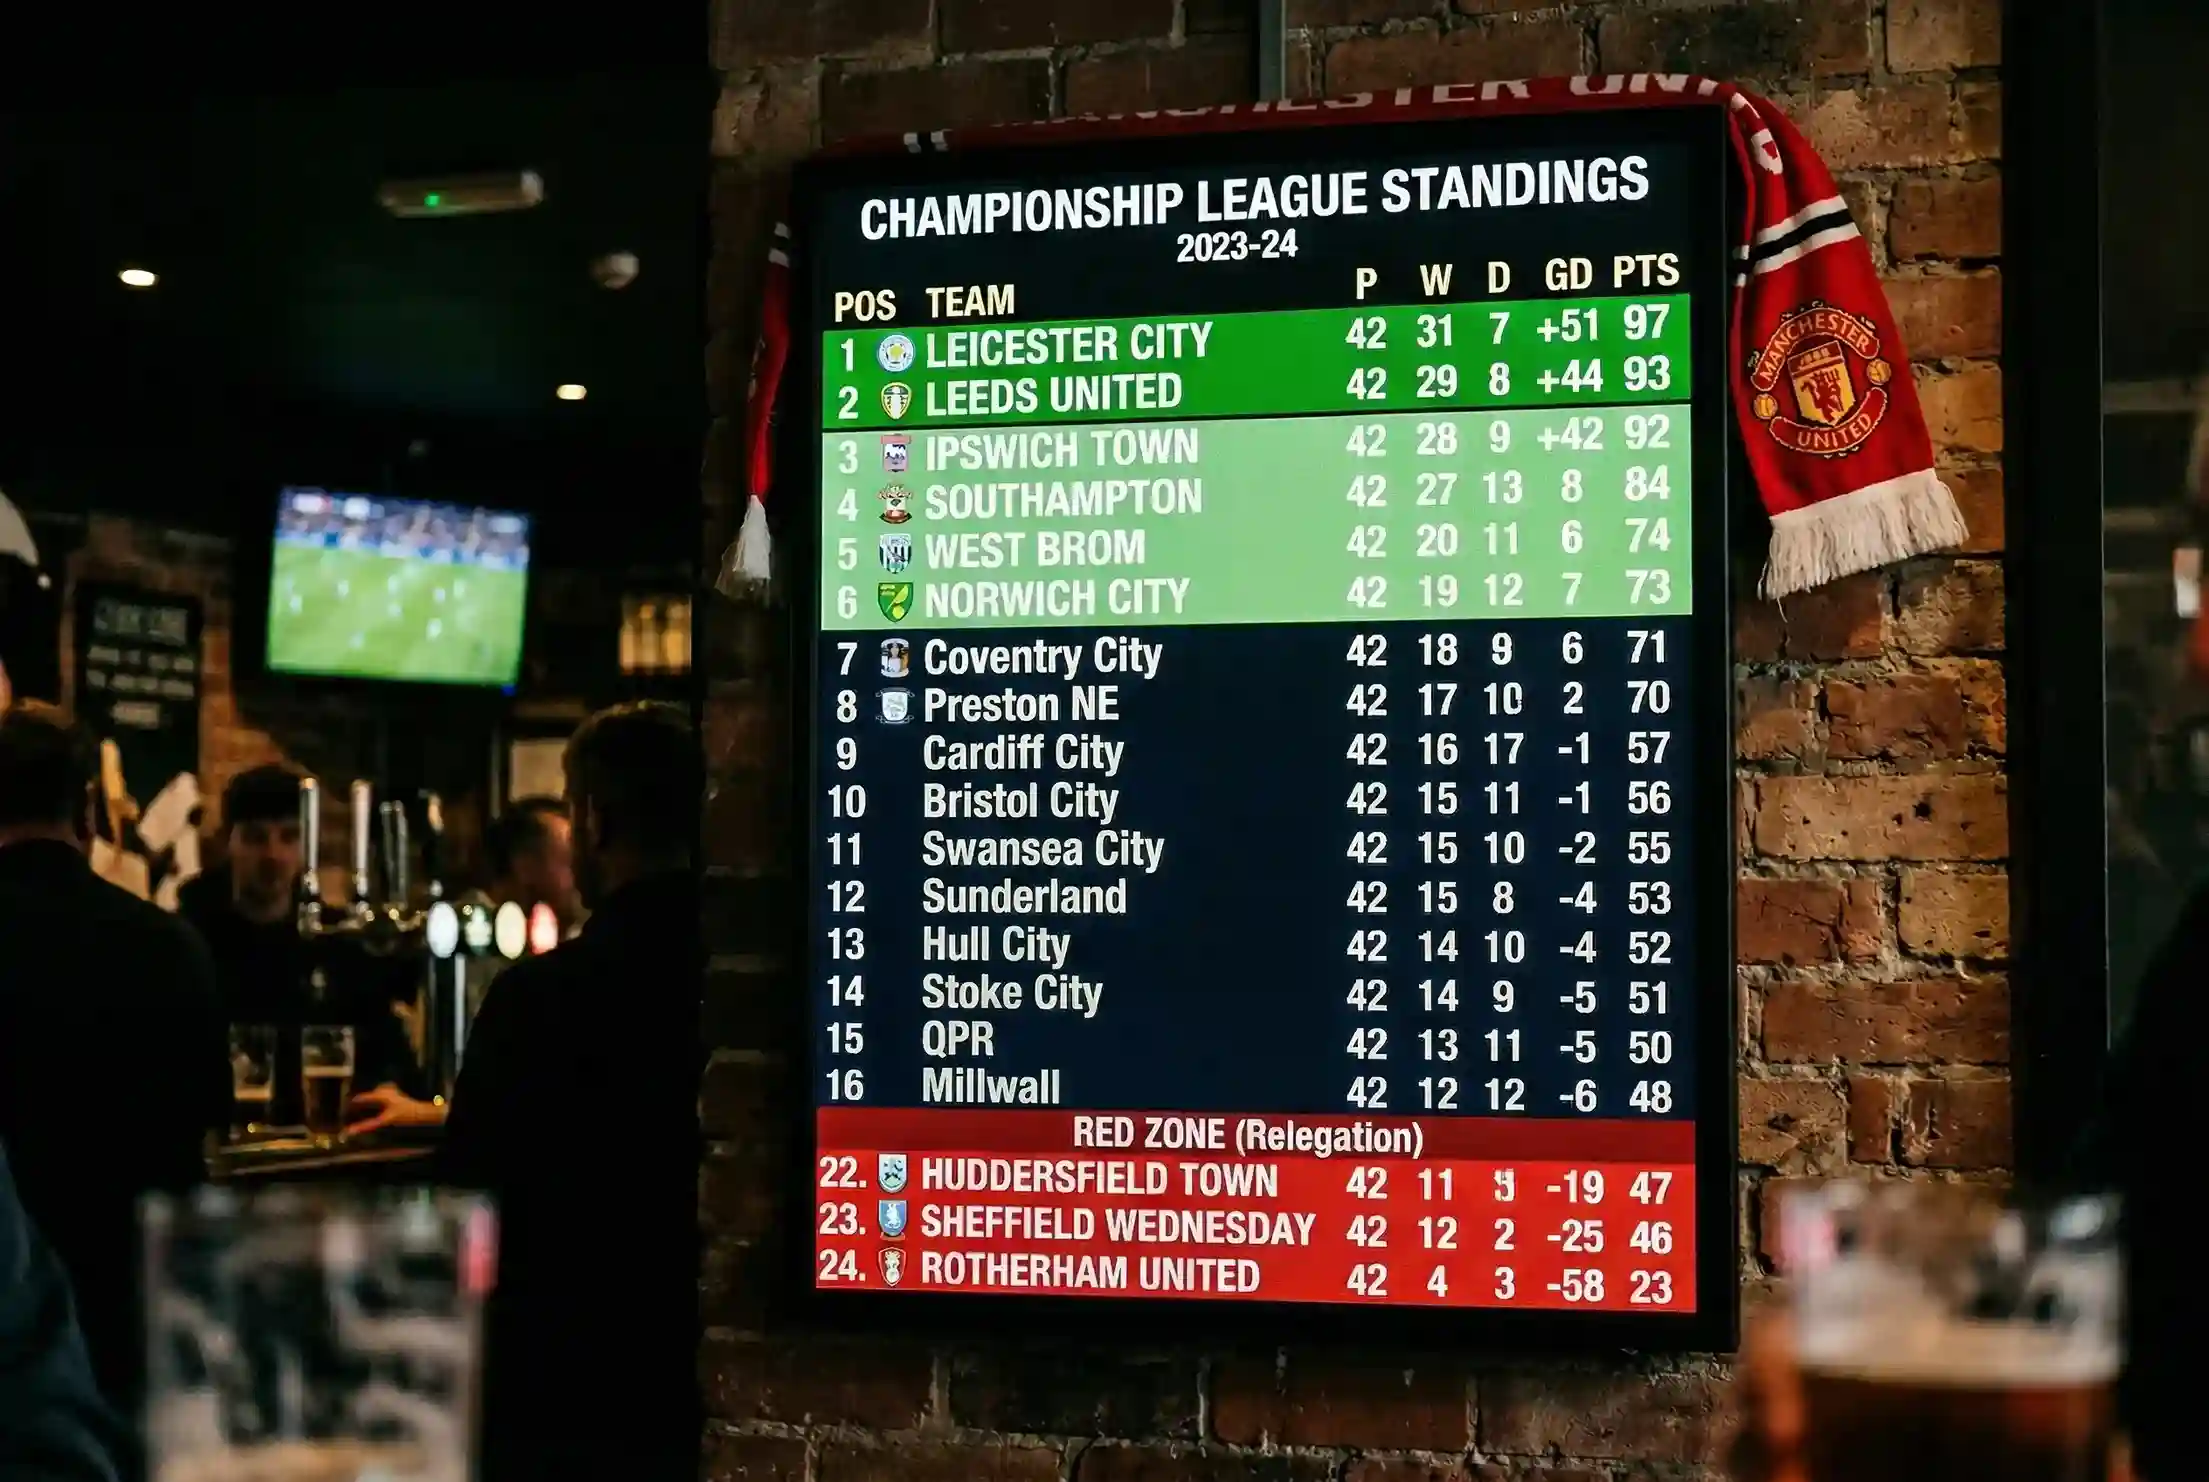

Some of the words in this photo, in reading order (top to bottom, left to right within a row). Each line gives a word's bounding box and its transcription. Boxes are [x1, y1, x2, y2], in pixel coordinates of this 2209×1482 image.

[860, 182, 1184, 241] CHAMPIONSHIP
[1197, 171, 1368, 223] LEAGUE
[1381, 155, 1649, 213] STANDINGS
[1176, 227, 1299, 263] 2023-24
[834, 289, 897, 323] POS
[925, 283, 1015, 319] TEAM
[1356, 267, 1378, 300] P
[1419, 263, 1453, 297] W
[1488, 260, 1511, 294] D
[1545, 257, 1593, 291] GD
[1613, 252, 1680, 289] PTS
[840, 338, 854, 372] 1
[926, 325, 1119, 369] LEICESTER
[1130, 321, 1214, 361] CITY
[1344, 316, 1387, 350] 42
[1416, 313, 1452, 348] 31
[1489, 311, 1510, 345] 7
[1536, 307, 1598, 343] +51
[1623, 303, 1670, 341] 97
[1759, 312, 1870, 383] MANCHESTER
[838, 385, 859, 420] 2
[926, 377, 1039, 417] LEEDS
[1050, 372, 1182, 413] UNITED
[1346, 366, 1387, 401] 42
[1416, 363, 1458, 398] 29
[1488, 362, 1511, 396] 8
[1536, 358, 1604, 394] +44
[1623, 354, 1671, 392] 93
[838, 439, 859, 474] 3
[926, 430, 1078, 471] IPSWICH
[1090, 427, 1199, 466] TOWN
[1345, 423, 1387, 458] 42
[1416, 421, 1458, 456] 28
[1489, 419, 1511, 454] 9
[1536, 415, 1604, 452] +42
[1623, 412, 1671, 450] 92
[1797, 412, 1872, 448] UNITED
[836, 488, 859, 522] 4
[925, 477, 1202, 520] SOUTHAMPTON
[1346, 474, 1388, 508] 42
[1415, 472, 1458, 506] 27
[1482, 469, 1524, 505] 13
[1560, 468, 1584, 503] 8
[1623, 464, 1671, 502] 84
[837, 537, 858, 571] 5
[924, 531, 1026, 570] WEST
[1037, 528, 1146, 567] BROM
[1346, 524, 1387, 559] 42
[1416, 522, 1459, 558] 20
[1483, 521, 1518, 555] 11
[1561, 519, 1584, 554] 6
[1625, 517, 1672, 553] 74
[836, 585, 858, 620] 6
[925, 579, 1096, 618] NORWICH
[1108, 577, 1191, 615] CITY
[1346, 575, 1388, 609] 42
[1418, 574, 1459, 608] 19
[1483, 572, 1524, 607] 12
[1561, 572, 1583, 606] 7
[1625, 568, 1671, 605] 73
[837, 641, 858, 676] 7
[924, 638, 1083, 681] Coventry
[1094, 635, 1163, 680] City
[1346, 634, 1388, 667] 42
[1418, 633, 1458, 666] 18
[1491, 632, 1513, 666] 9
[1562, 631, 1584, 665] 6
[1626, 629, 1665, 664] 71
[836, 689, 858, 723] 8
[924, 687, 1059, 723] Preston
[1071, 685, 1120, 721] NE
[1345, 683, 1388, 717] 42
[1418, 682, 1458, 716] 17
[1483, 681, 1523, 715] 10
[1563, 681, 1584, 715] 2
[1627, 679, 1671, 714] 70
[836, 737, 857, 771] 9
[923, 733, 1045, 771] Cardiff
[1055, 733, 1125, 777] City
[1346, 732, 1388, 766] 42
[1418, 732, 1459, 765] 16
[1484, 732, 1525, 765] 17
[1558, 731, 1589, 764] -1
[1627, 730, 1671, 764] 57
[827, 784, 866, 818] 10
[923, 781, 1038, 818] Bristol
[1050, 781, 1120, 826] City
[1346, 781, 1388, 815] 42
[1417, 781, 1458, 815] 15
[1484, 781, 1519, 814] 11
[1558, 780, 1589, 814] -1
[1627, 780, 1671, 815] 56
[827, 832, 861, 866] 11
[922, 830, 1083, 866] Swansea
[1095, 829, 1165, 874] City
[1346, 831, 1388, 864] 42
[1417, 831, 1458, 864] 15
[1483, 830, 1525, 864] 10
[1558, 830, 1596, 864] -2
[1627, 831, 1671, 865] 55
[827, 927, 865, 961] 13
[923, 925, 990, 962] Hull
[1002, 925, 1071, 970] City
[1346, 929, 1388, 962] 42
[1418, 930, 1459, 962] 14
[1484, 930, 1525, 964] 10
[1559, 930, 1597, 964] -4
[1628, 931, 1672, 964] 52
[826, 975, 865, 1007] 14
[922, 972, 1023, 1010] Stoke
[1034, 973, 1104, 1019] City
[1346, 978, 1388, 1012] 42
[1418, 979, 1459, 1012] 14
[1492, 980, 1514, 1013] 9
[1559, 980, 1597, 1014] -5
[1628, 980, 1666, 1015] 51
[922, 1019, 994, 1059] QPR
[826, 1068, 864, 1101] 16
[922, 1066, 1060, 1105] Millwall
[1346, 1076, 1388, 1109] 42
[1418, 1076, 1458, 1110] 12
[1484, 1077, 1525, 1111] 12
[1559, 1078, 1597, 1113] -6
[1629, 1080, 1673, 1114] 48
[1074, 1115, 1135, 1148] RED
[1144, 1116, 1226, 1149] ZONE
[1235, 1118, 1424, 1160] (Relegation)
[819, 1155, 867, 1188] 22.
[922, 1157, 1168, 1195] HUDDERSFIELD
[1179, 1162, 1278, 1198] TOWN
[1345, 1166, 1388, 1200] 42
[1418, 1167, 1453, 1201] 11
[1547, 1169, 1605, 1205] -19
[1629, 1171, 1673, 1205] 47
[819, 1201, 866, 1235] 23.
[921, 1203, 1095, 1240] SHEFFIELD
[1104, 1208, 1317, 1246] WEDNESDAY
[1346, 1214, 1388, 1248] 42
[1417, 1215, 1458, 1250] 12
[1494, 1217, 1515, 1251] 2
[1547, 1218, 1605, 1253] -25
[1629, 1220, 1673, 1255] 46
[818, 1248, 866, 1282] 24.
[921, 1250, 1128, 1289] ROTHERHAM
[1139, 1256, 1260, 1293] UNITED
[1346, 1263, 1388, 1296] 42
[1426, 1264, 1449, 1298] 4
[1494, 1266, 1515, 1300] 3
[1546, 1268, 1605, 1302] -58
[1629, 1269, 1673, 1305] 23
